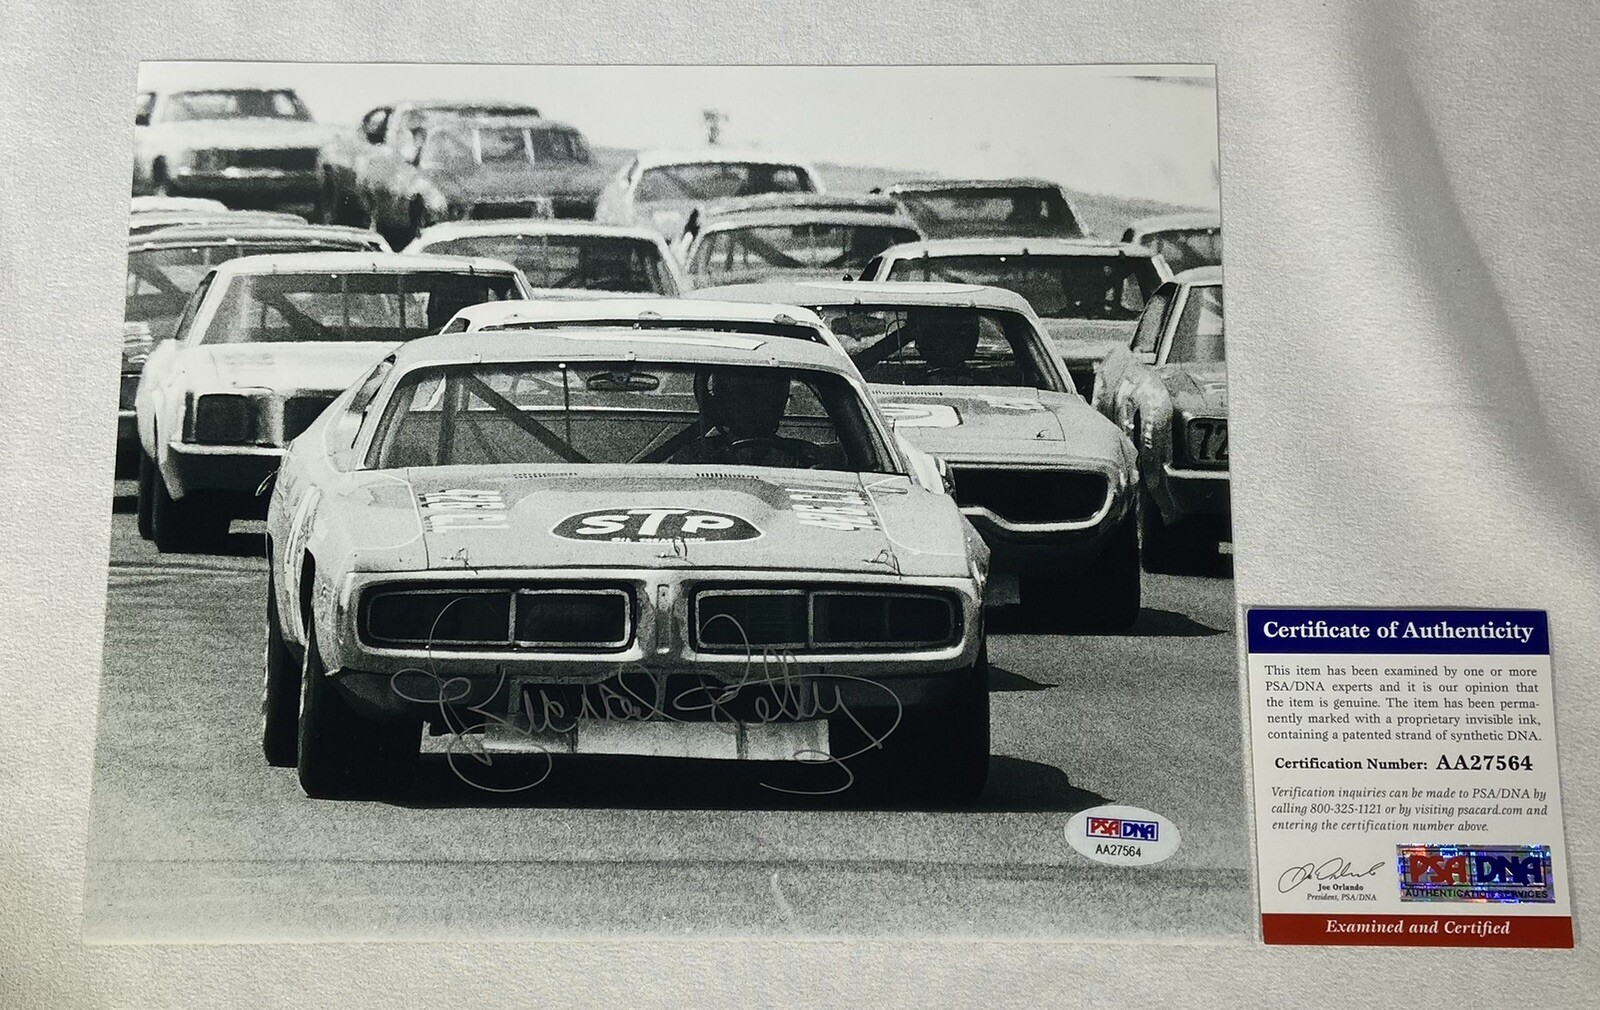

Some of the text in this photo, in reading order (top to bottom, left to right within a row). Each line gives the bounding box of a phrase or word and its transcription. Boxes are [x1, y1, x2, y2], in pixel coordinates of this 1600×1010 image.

[575, 509, 735, 537] STP
[1263, 620, 1533, 643] Certificate of Authenticity
[1264, 664, 1537, 678] This item has been examined by one or more
[1265, 680, 1539, 695] PSA/DNA experts and it is our opinion that
[1266, 696, 1539, 711] the item is genuine. The item has been perma-
[1267, 712, 1540, 726] nently marked with a proprietary invisible ink,
[1267, 728, 1541, 742] containing a patented strand of synthetic DNA.
[1274, 754, 1532, 770] Certification Number: AA27564
[1271, 786, 1546, 801] Verification inquiries can be made to PSA/DNA by
[1271, 802, 1547, 817] calling 800-325-1121 or by visiting psacard.com and
[1090, 819, 1155, 840] PSA DNA
[1272, 819, 1488, 833] entering the certification number above.
[1095, 843, 1141, 857] AA27564
[1409, 855, 1544, 886] PSA DNA
[1317, 883, 1365, 892] Joe Orlando
[1306, 893, 1377, 902] President, PSA/DNA
[1325, 919, 1509, 937] Examined and Certified
